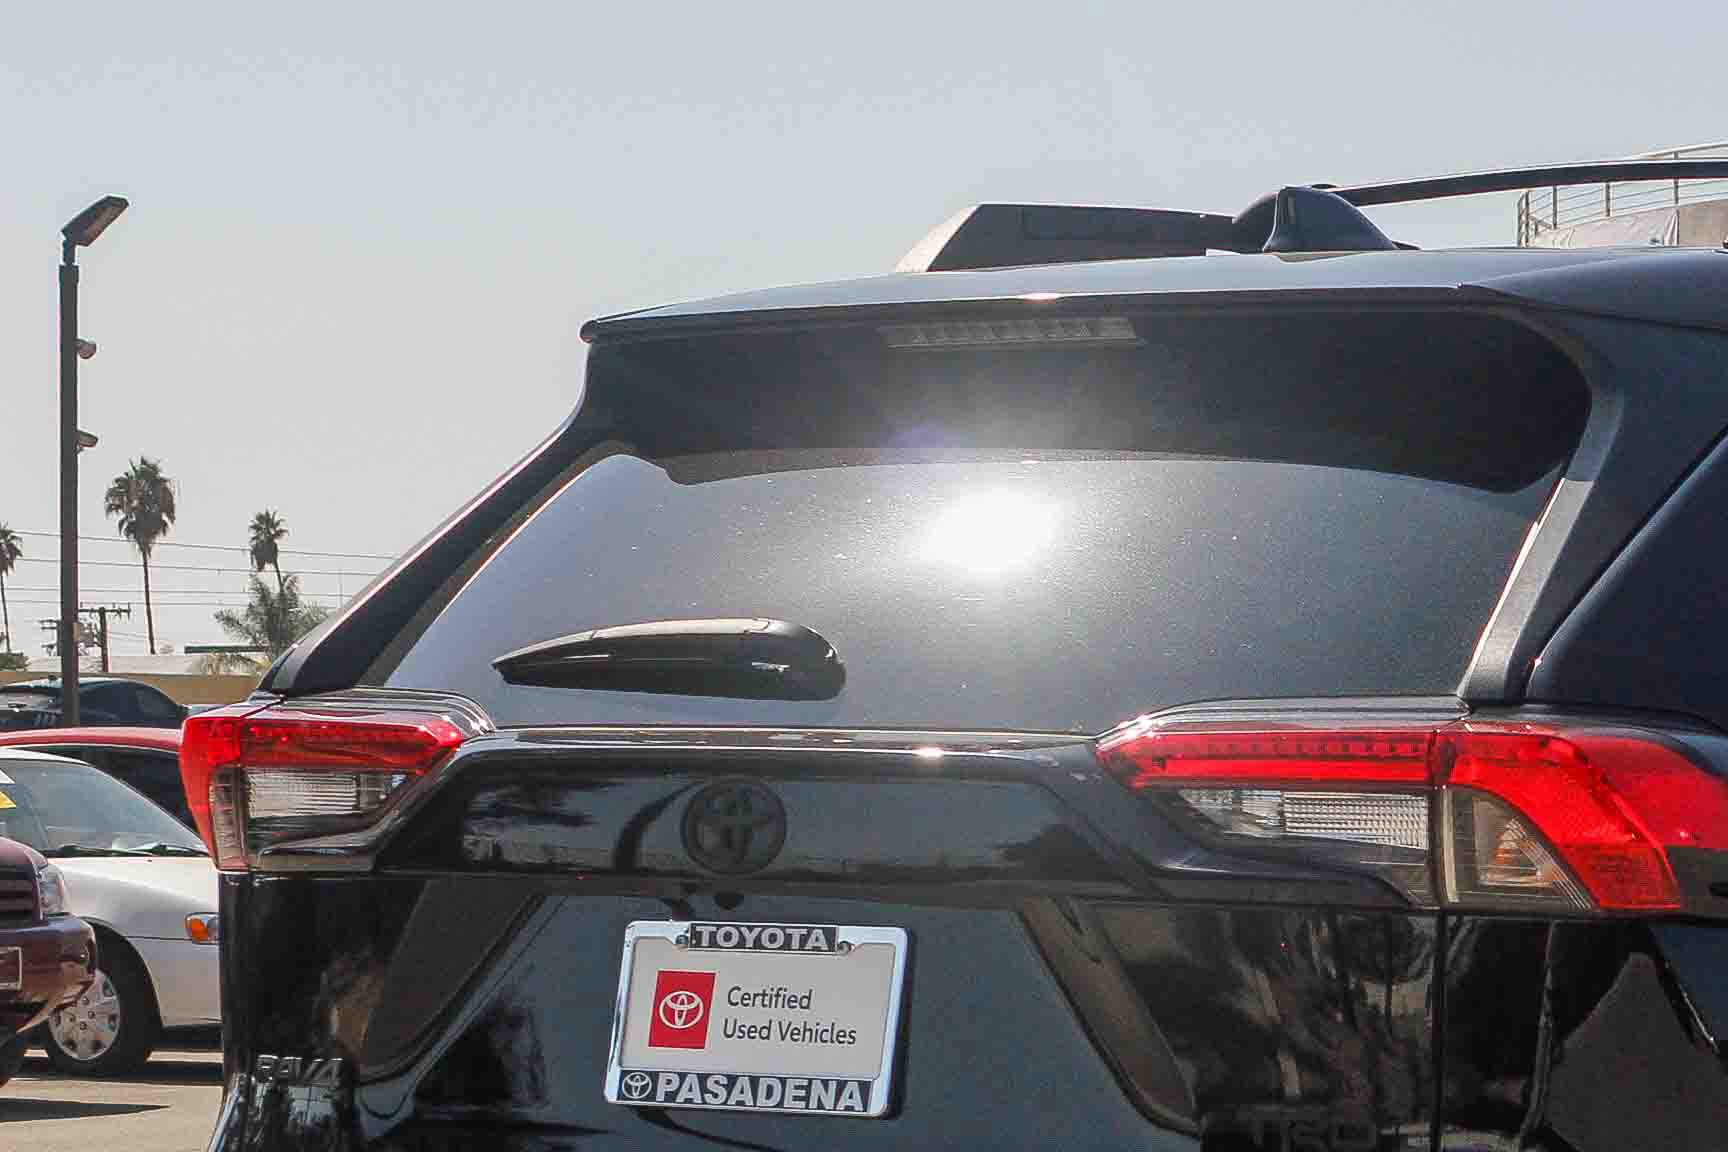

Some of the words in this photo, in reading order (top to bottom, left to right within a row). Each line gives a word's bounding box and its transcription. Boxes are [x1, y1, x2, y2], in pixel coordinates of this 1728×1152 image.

[695, 925, 830, 951] TOYOTA
[727, 986, 813, 1011] Certified
[722, 1018, 772, 1041] Used
[778, 1020, 857, 1045] Vehicles
[655, 1072, 864, 1112] PASADENA
